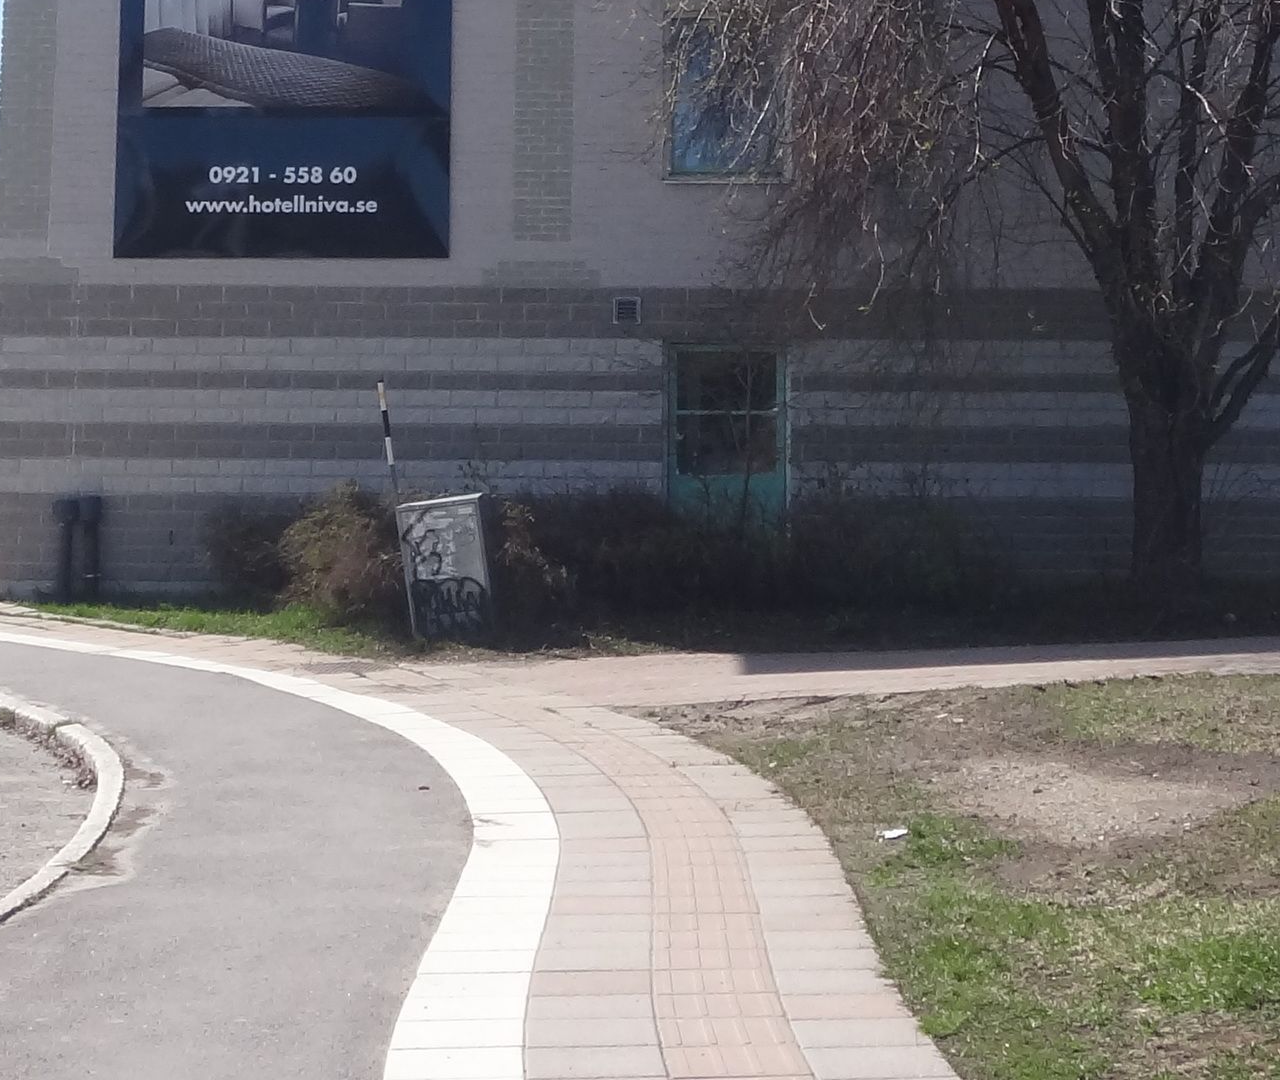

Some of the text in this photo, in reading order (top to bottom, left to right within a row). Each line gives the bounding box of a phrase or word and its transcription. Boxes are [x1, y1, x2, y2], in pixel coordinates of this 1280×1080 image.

[208, 166, 260, 184] 0921
[283, 166, 324, 184] 558
[329, 166, 357, 184] 60
[184, 194, 378, 213] www.hotellniva.se
